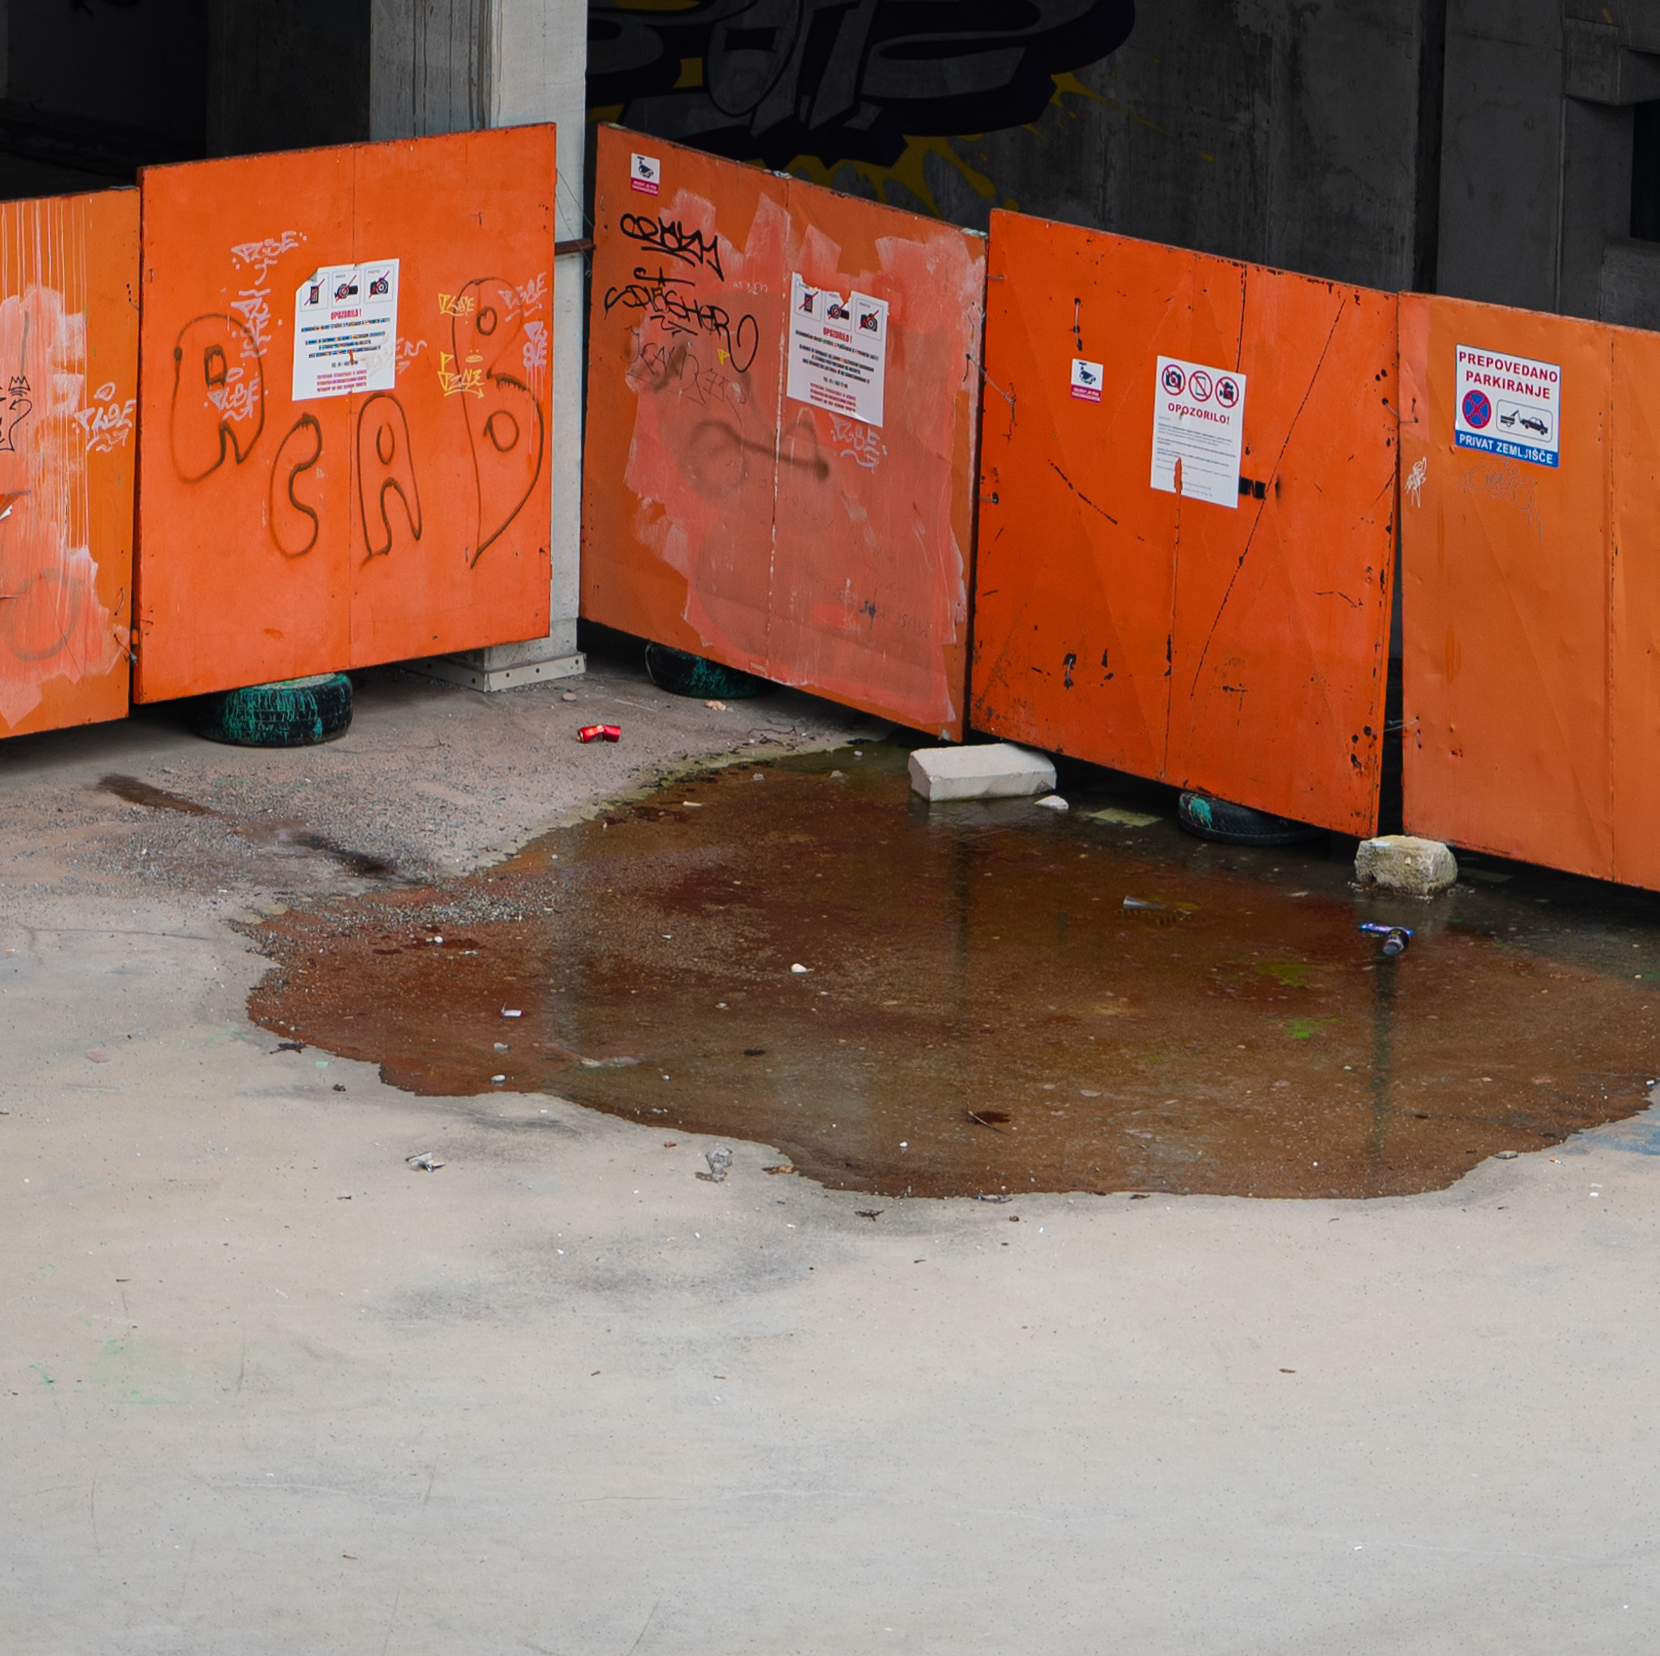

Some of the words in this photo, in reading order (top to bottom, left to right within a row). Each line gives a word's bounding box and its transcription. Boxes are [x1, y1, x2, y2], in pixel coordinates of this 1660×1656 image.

[1459, 351, 1558, 383] PREPOVEDANO
[1466, 370, 1551, 399] PARKIRANJE
[1168, 402, 1230, 425] OPOZORILO!
[1459, 433, 1494, 451] PRIVAT
[1496, 443, 1554, 465] ZEMLJIŠČE
